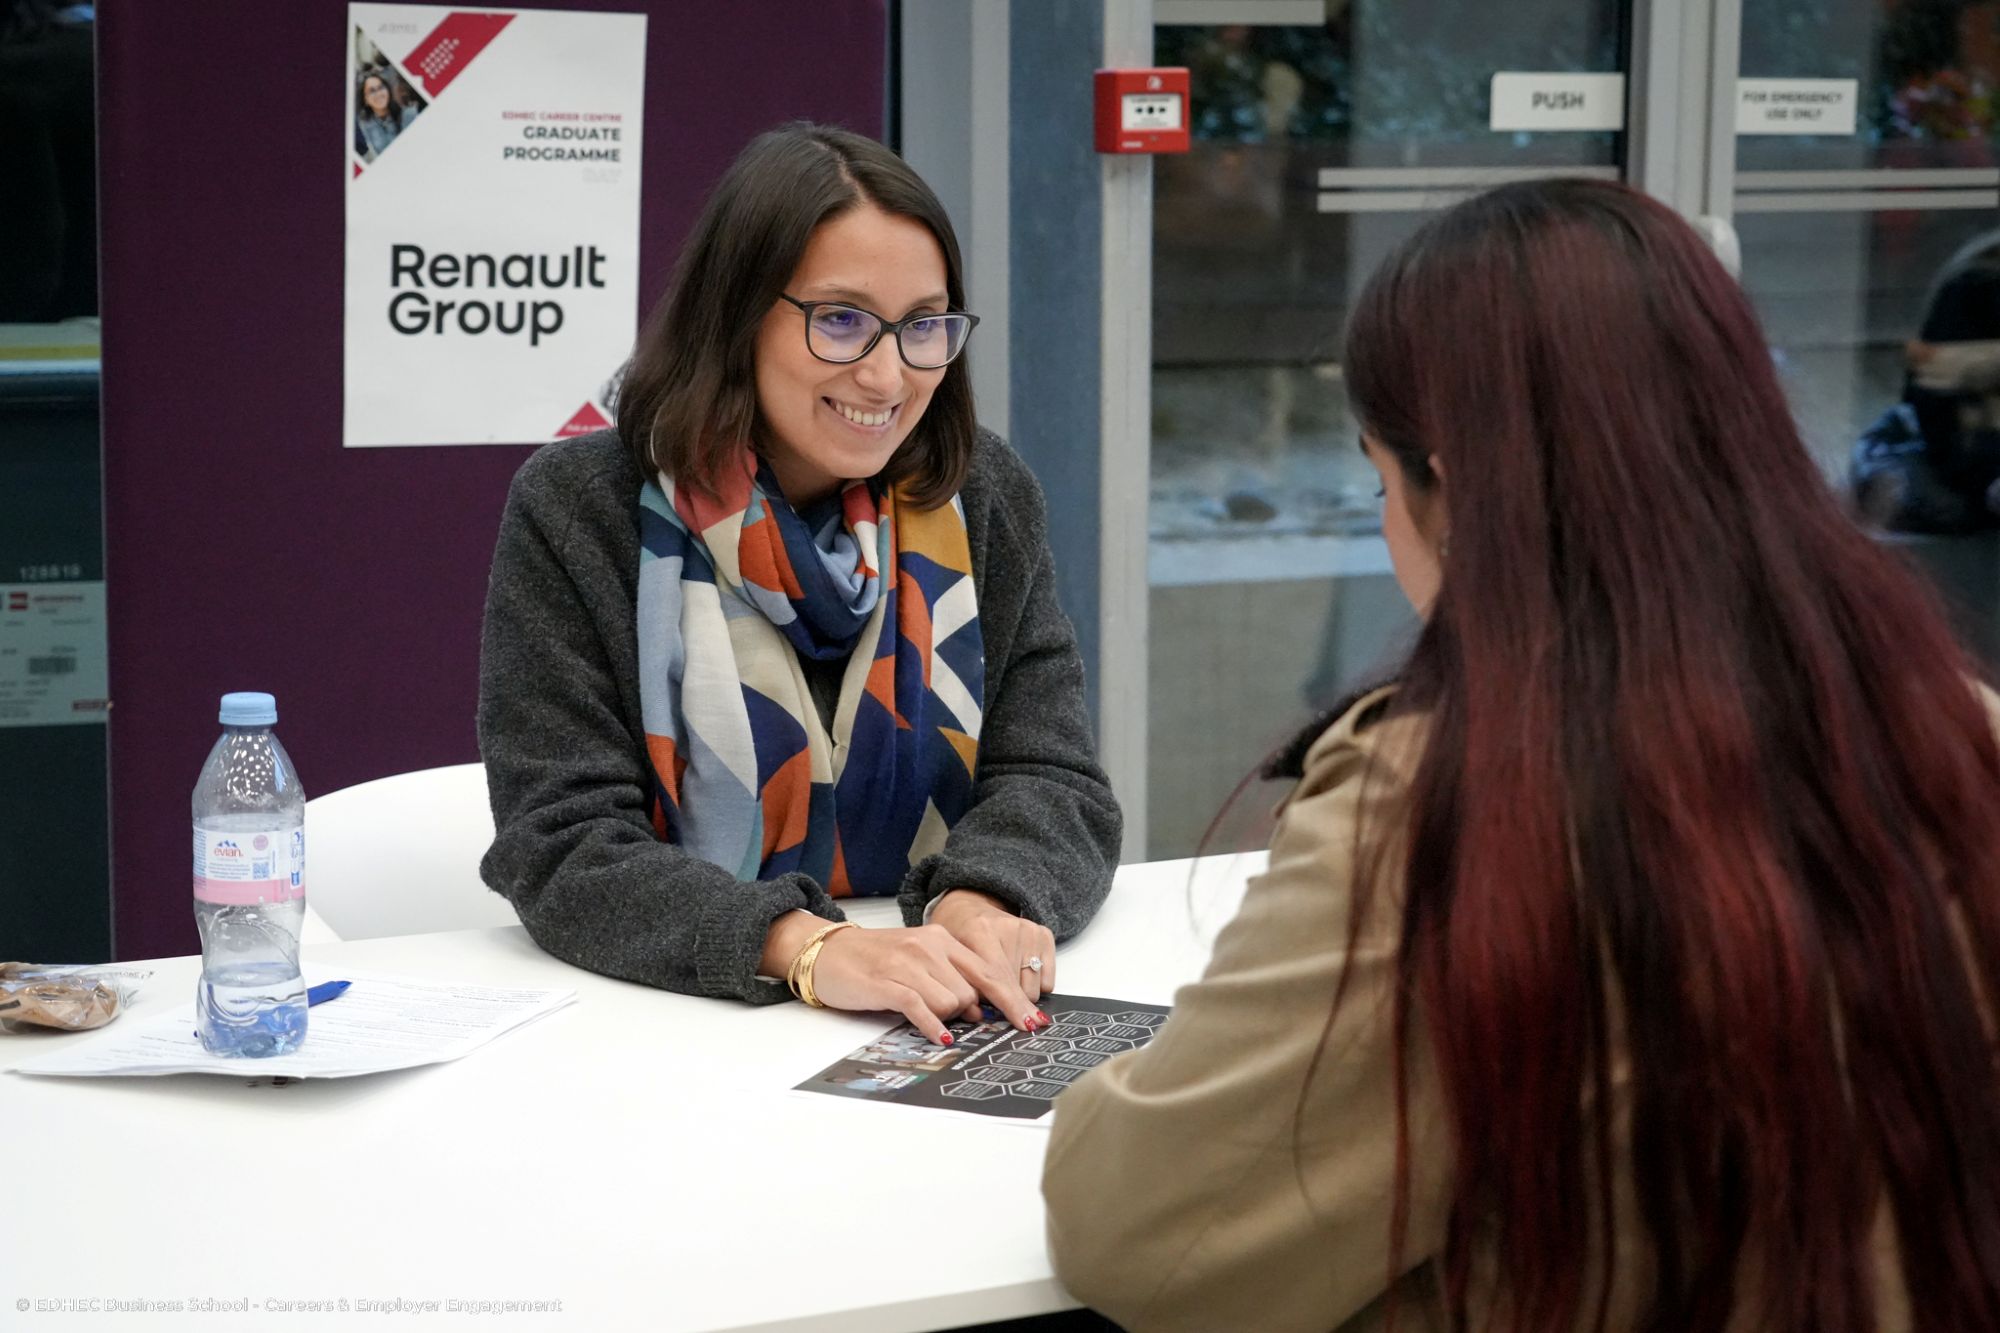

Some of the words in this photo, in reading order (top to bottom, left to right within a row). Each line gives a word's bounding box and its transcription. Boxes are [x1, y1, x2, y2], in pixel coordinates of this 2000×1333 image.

[1531, 91, 1585, 111] PUSH
[1742, 91, 1767, 104] FOR
[1771, 91, 1843, 104] EMERGENCY
[501, 111, 537, 121] EDHEC
[540, 112, 580, 122] CAREER
[583, 113, 622, 123] CENTRE
[1766, 107, 1788, 121] USE
[1792, 107, 1822, 121] ONLY
[522, 125, 622, 142] GRADUATE
[503, 146, 621, 163] PROGRAMME
[390, 243, 606, 289] Renault
[387, 290, 565, 347] Group
